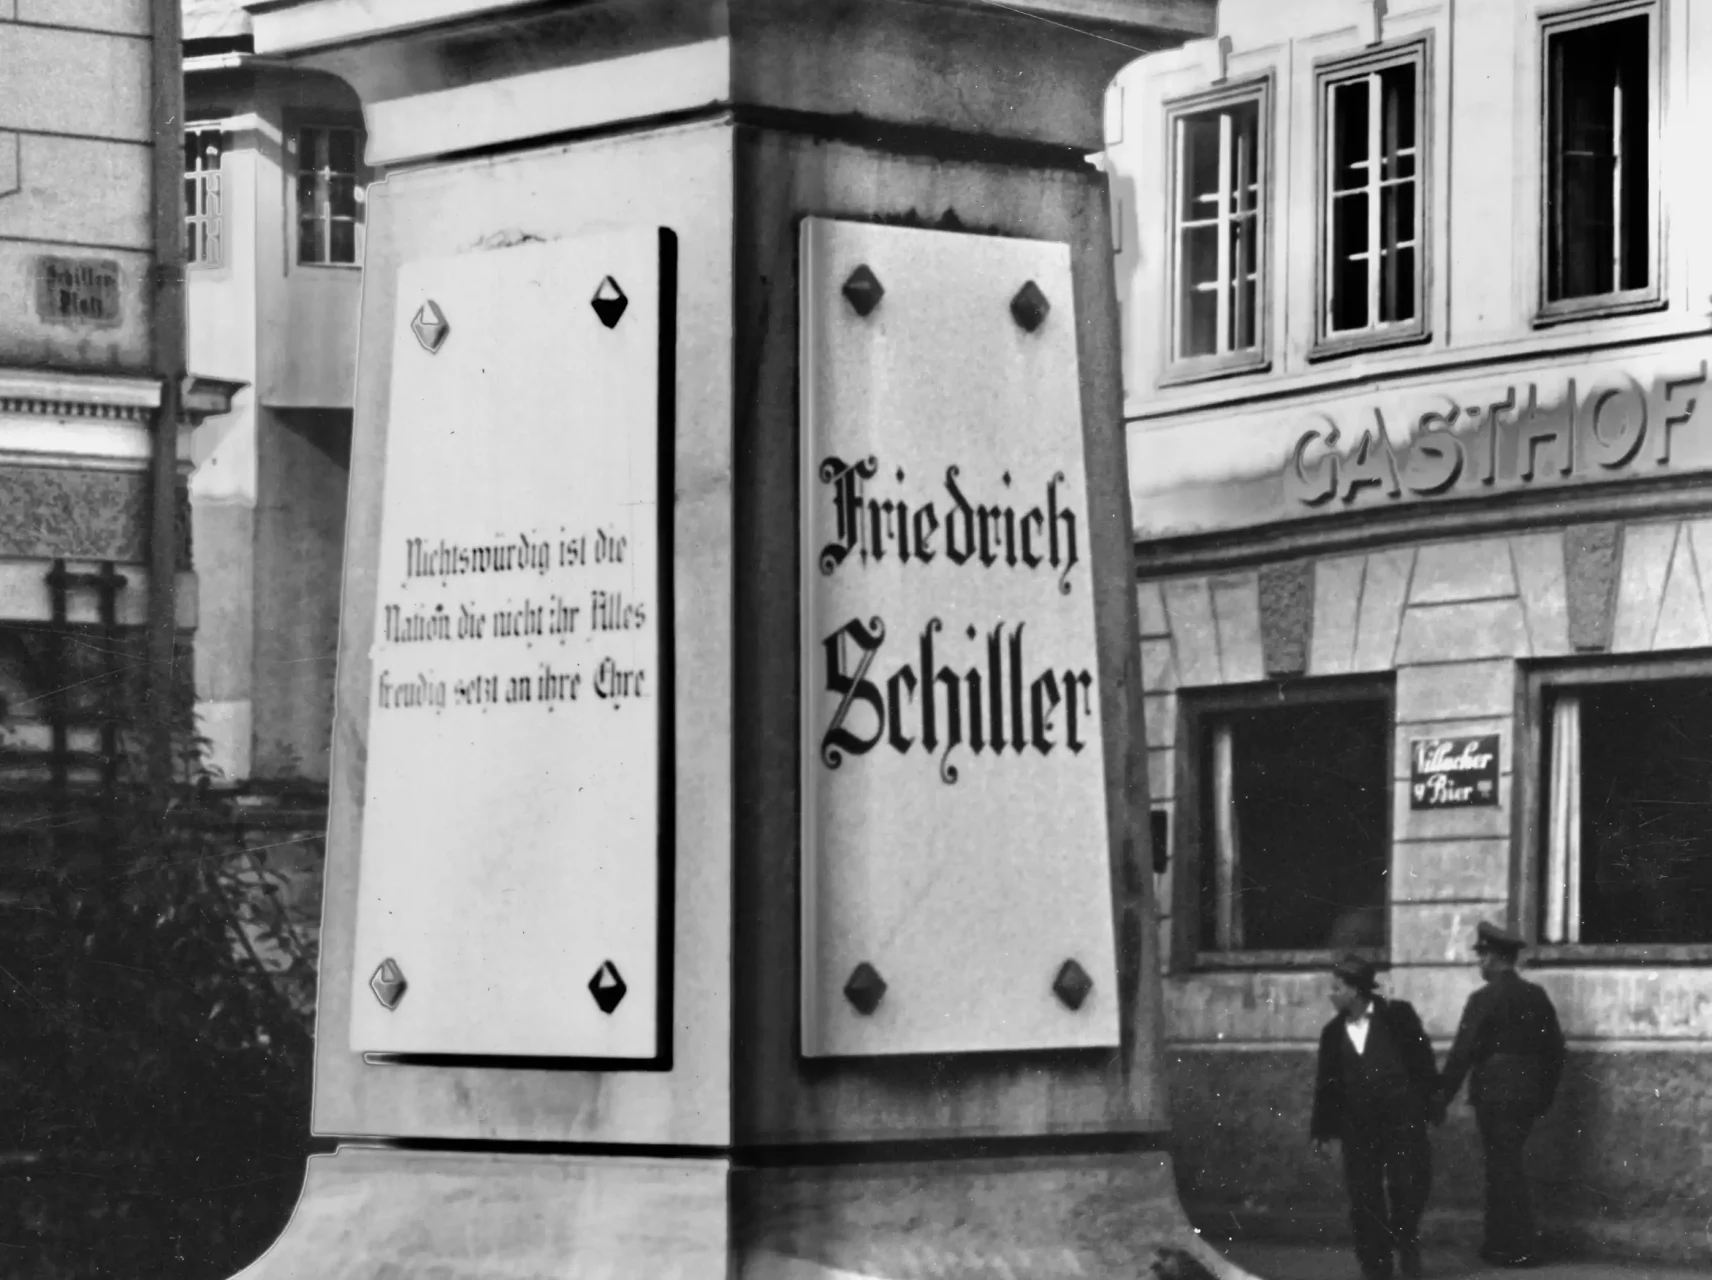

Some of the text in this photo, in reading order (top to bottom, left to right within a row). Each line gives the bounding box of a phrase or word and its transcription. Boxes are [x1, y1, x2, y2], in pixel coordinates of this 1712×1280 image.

[1293, 360, 1708, 508] GASTHOF
[559, 524, 587, 567] ist
[594, 523, 628, 565] die
[819, 454, 1079, 595] Friedrich
[457, 600, 486, 640] die
[493, 598, 544, 648] nicht
[549, 593, 580, 645] ihr
[590, 589, 646, 634] Alles
[378, 669, 446, 716] freudig
[505, 674, 532, 704] an
[538, 663, 582, 713] ihre
[593, 656, 646, 711] Ehre
[821, 615, 1092, 784] Schiller
[1426, 773, 1473, 804] Bier
